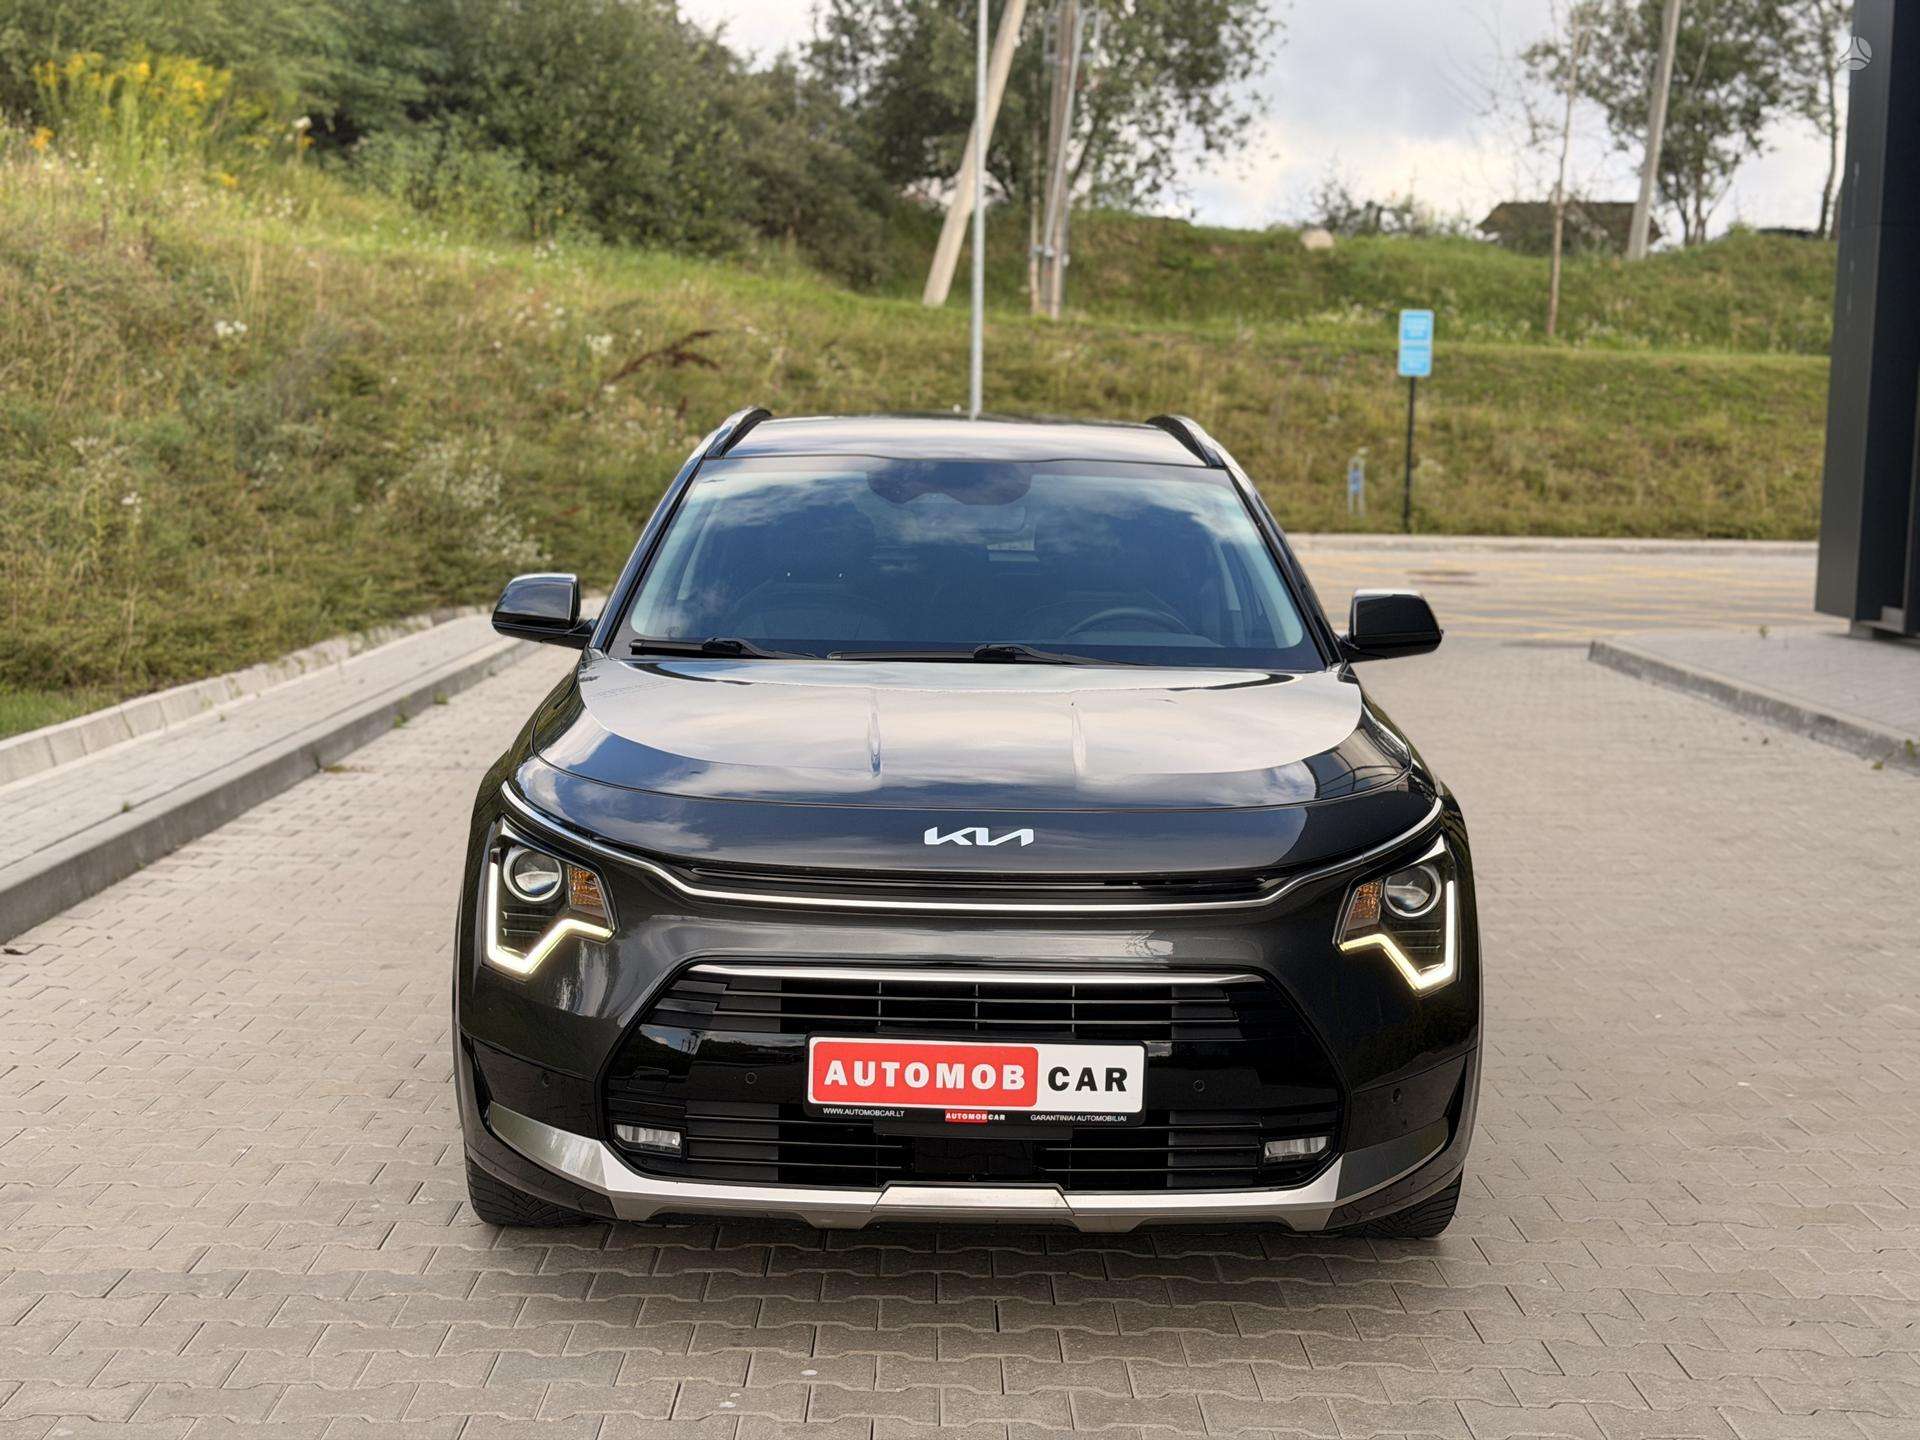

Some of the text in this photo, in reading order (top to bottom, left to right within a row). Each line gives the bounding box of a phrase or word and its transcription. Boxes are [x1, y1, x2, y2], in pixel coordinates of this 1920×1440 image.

[924, 826, 1034, 847] KIA
[823, 1059, 1129, 1092] AUTOMOB CAR
[822, 1107, 905, 1117] WWW.AUTOMOBCAR.LT
[1030, 1113, 1127, 1122] GARANTINIAI AUTOMOBILIAI
